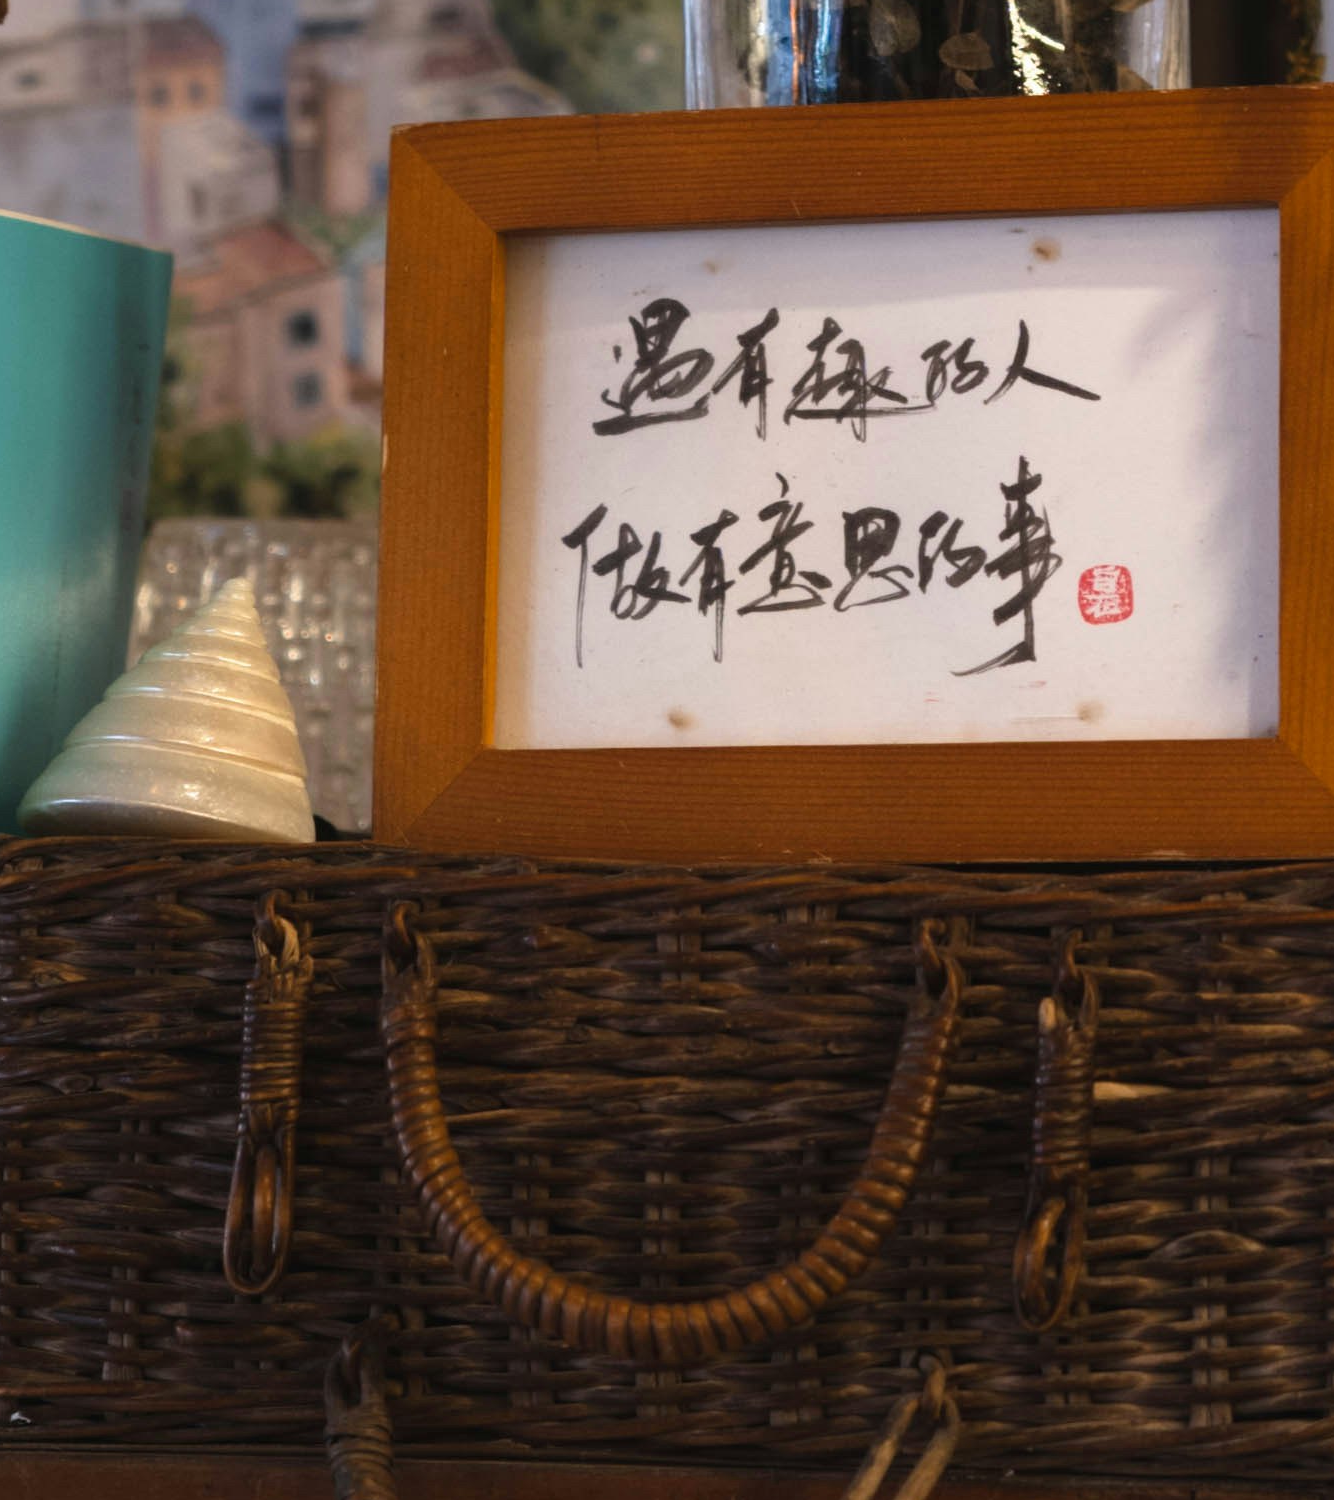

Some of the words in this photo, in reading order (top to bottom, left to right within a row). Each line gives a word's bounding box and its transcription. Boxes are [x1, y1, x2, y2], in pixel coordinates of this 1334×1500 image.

[592, 297, 1101, 442] 遇有趣的人
[561, 455, 1064, 677] 做有意思的事
